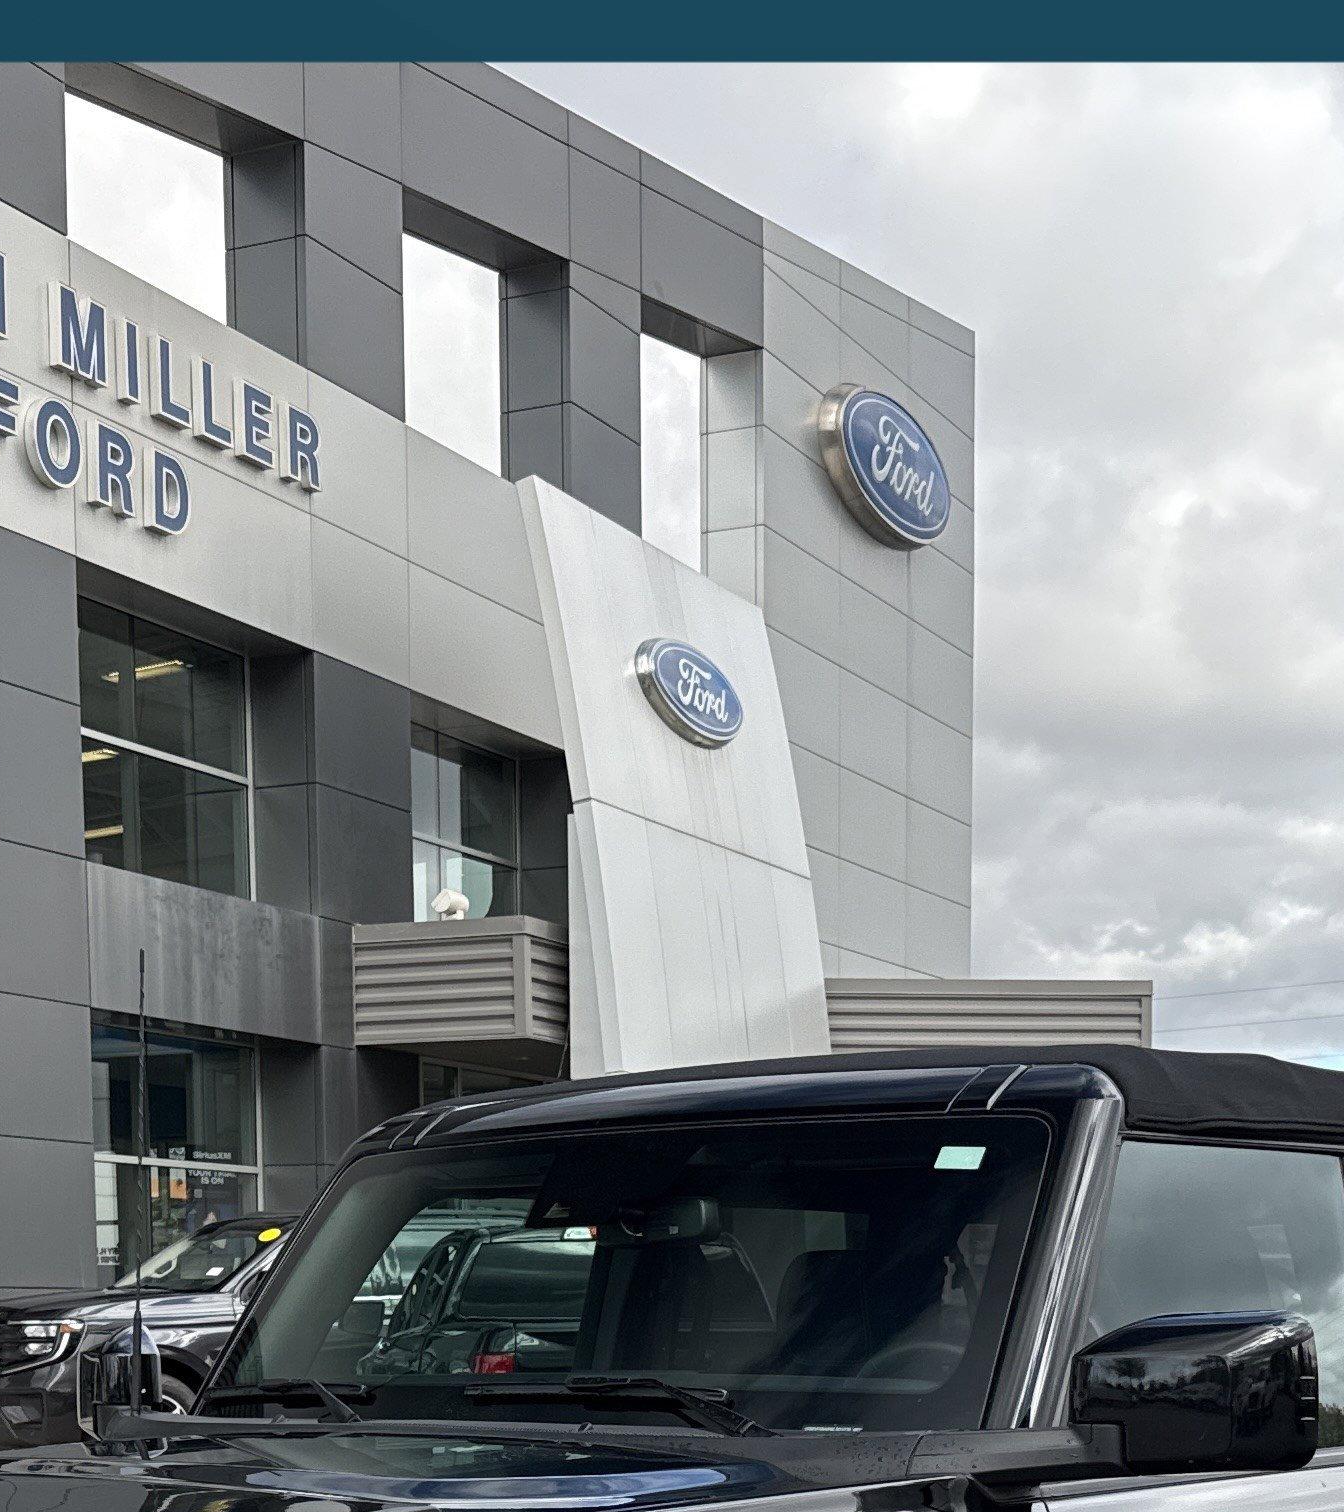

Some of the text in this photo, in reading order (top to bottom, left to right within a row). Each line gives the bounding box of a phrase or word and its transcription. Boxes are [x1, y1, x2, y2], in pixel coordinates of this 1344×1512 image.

[47, 281, 323, 493] MILLER
[871, 415, 935, 517] Ford
[677, 658, 729, 723] Ford
